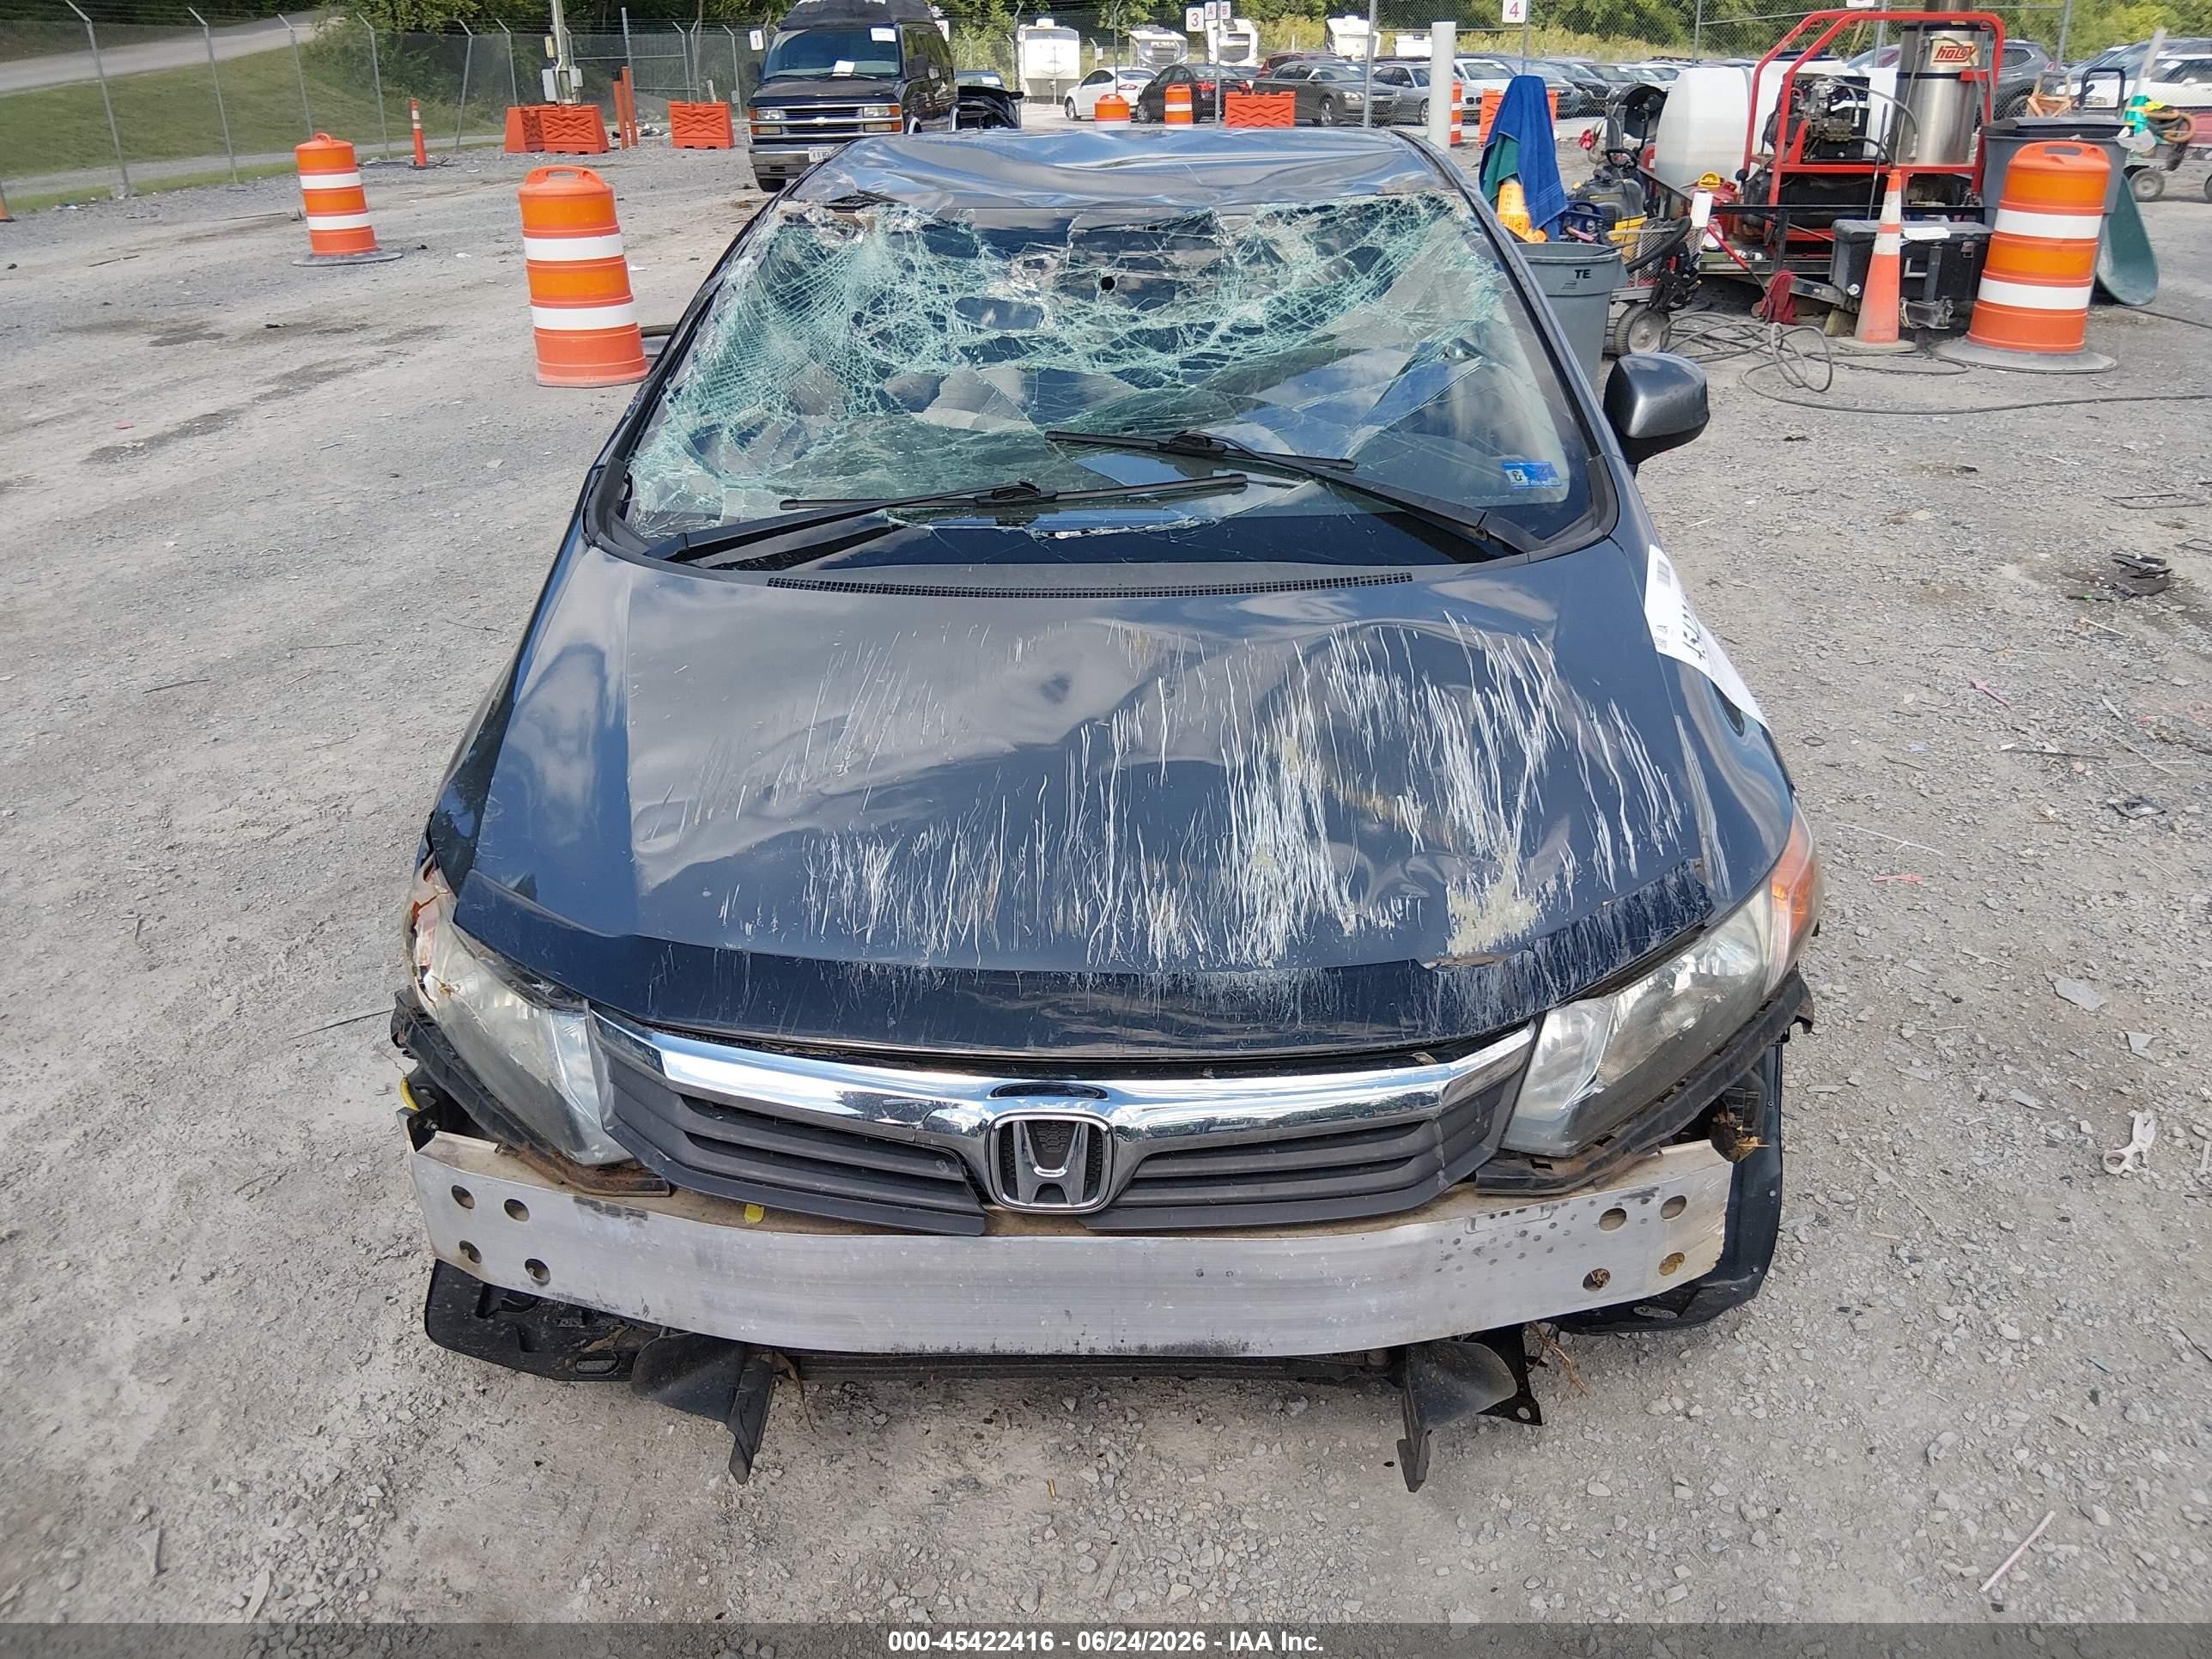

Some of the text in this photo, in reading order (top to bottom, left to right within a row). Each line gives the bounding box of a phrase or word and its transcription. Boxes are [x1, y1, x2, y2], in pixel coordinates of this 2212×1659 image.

[1222, 6, 1228, 15] B
[1509, 2, 1520, 18] 4
[1191, 12, 1199, 27] 3
[1574, 269, 1591, 279] TE
